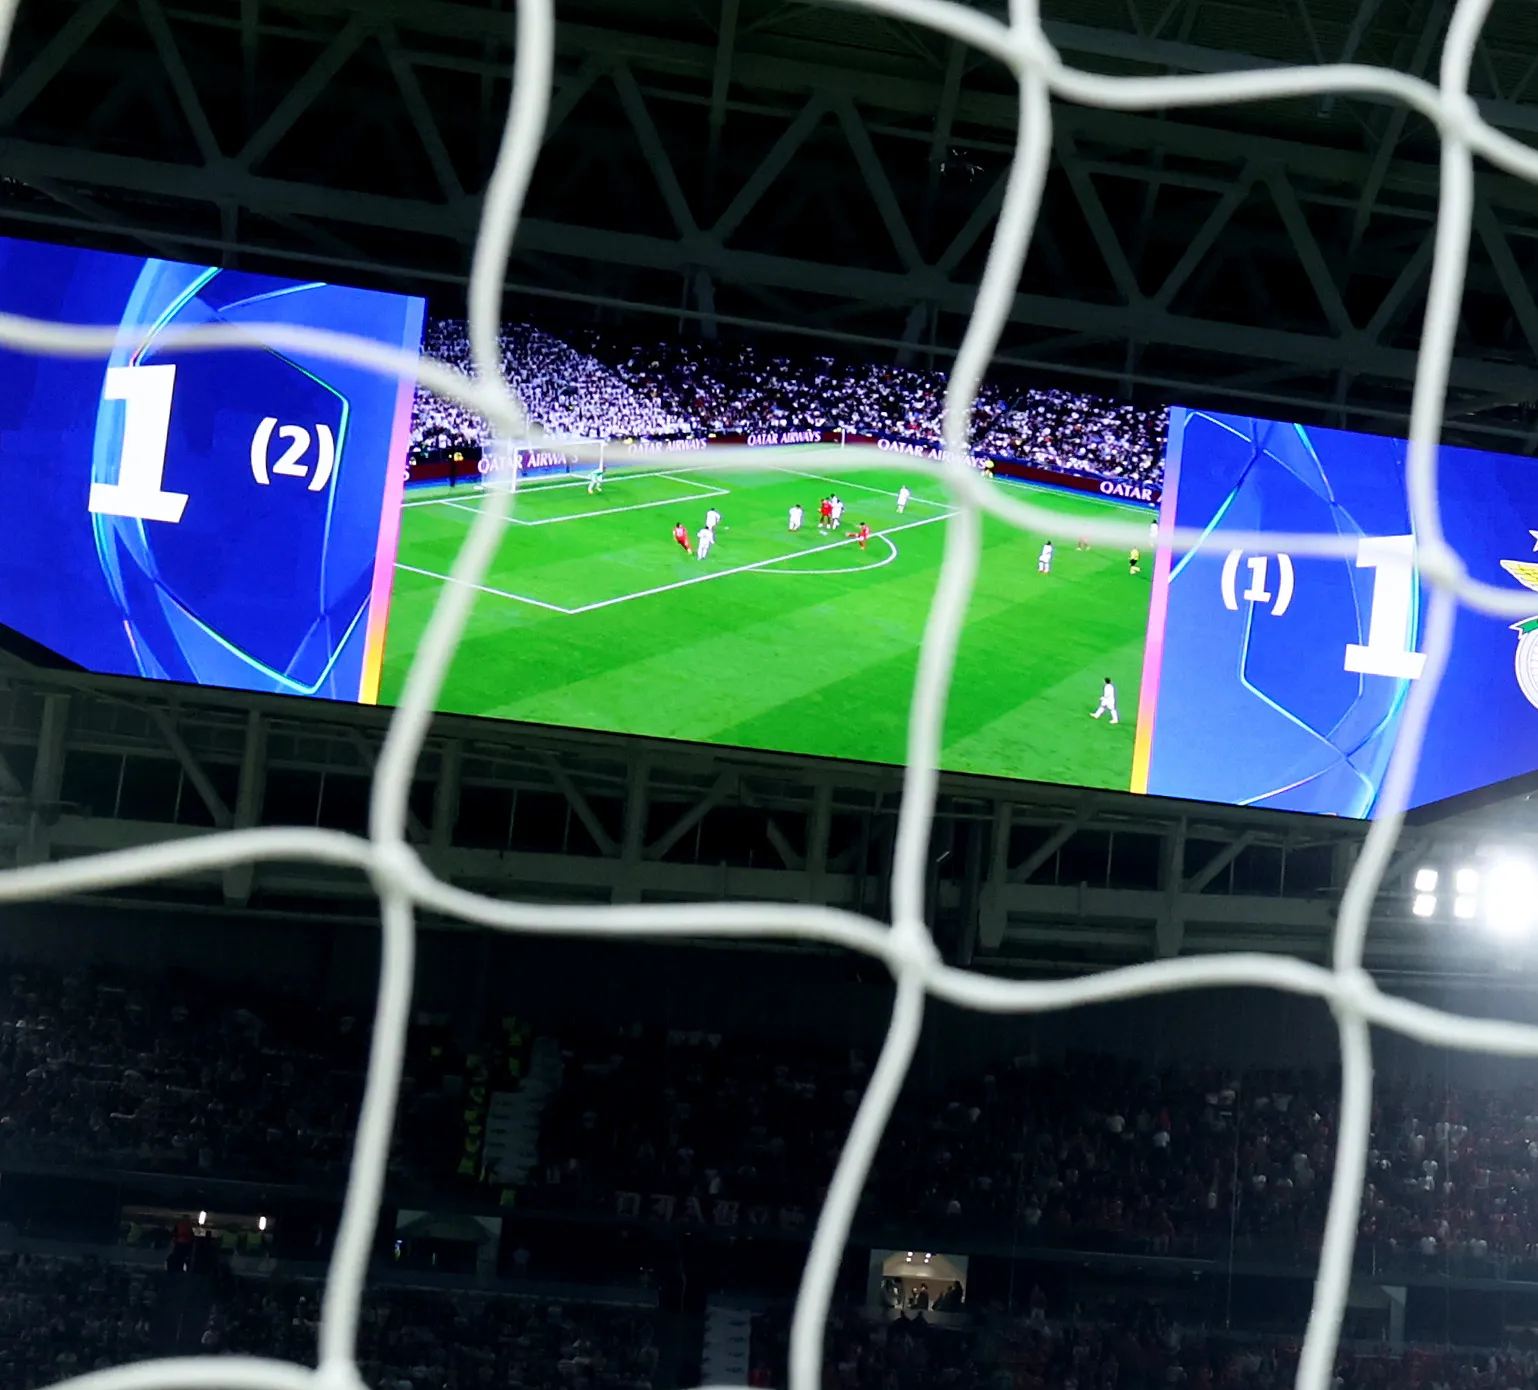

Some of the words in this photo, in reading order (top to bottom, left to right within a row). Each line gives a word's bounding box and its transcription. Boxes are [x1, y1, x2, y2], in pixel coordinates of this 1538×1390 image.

[88, 364, 191, 524] 1
[250, 416, 336, 492] (2)
[747, 432, 778, 447] QATAR
[781, 430, 821, 445] AIRWAYS
[877, 438, 924, 456] QATAR
[527, 451, 579, 469] AIRWAS
[1100, 480, 1153, 501] QATAR
[1220, 549, 1295, 617] (1)
[1344, 535, 1427, 680] 1
